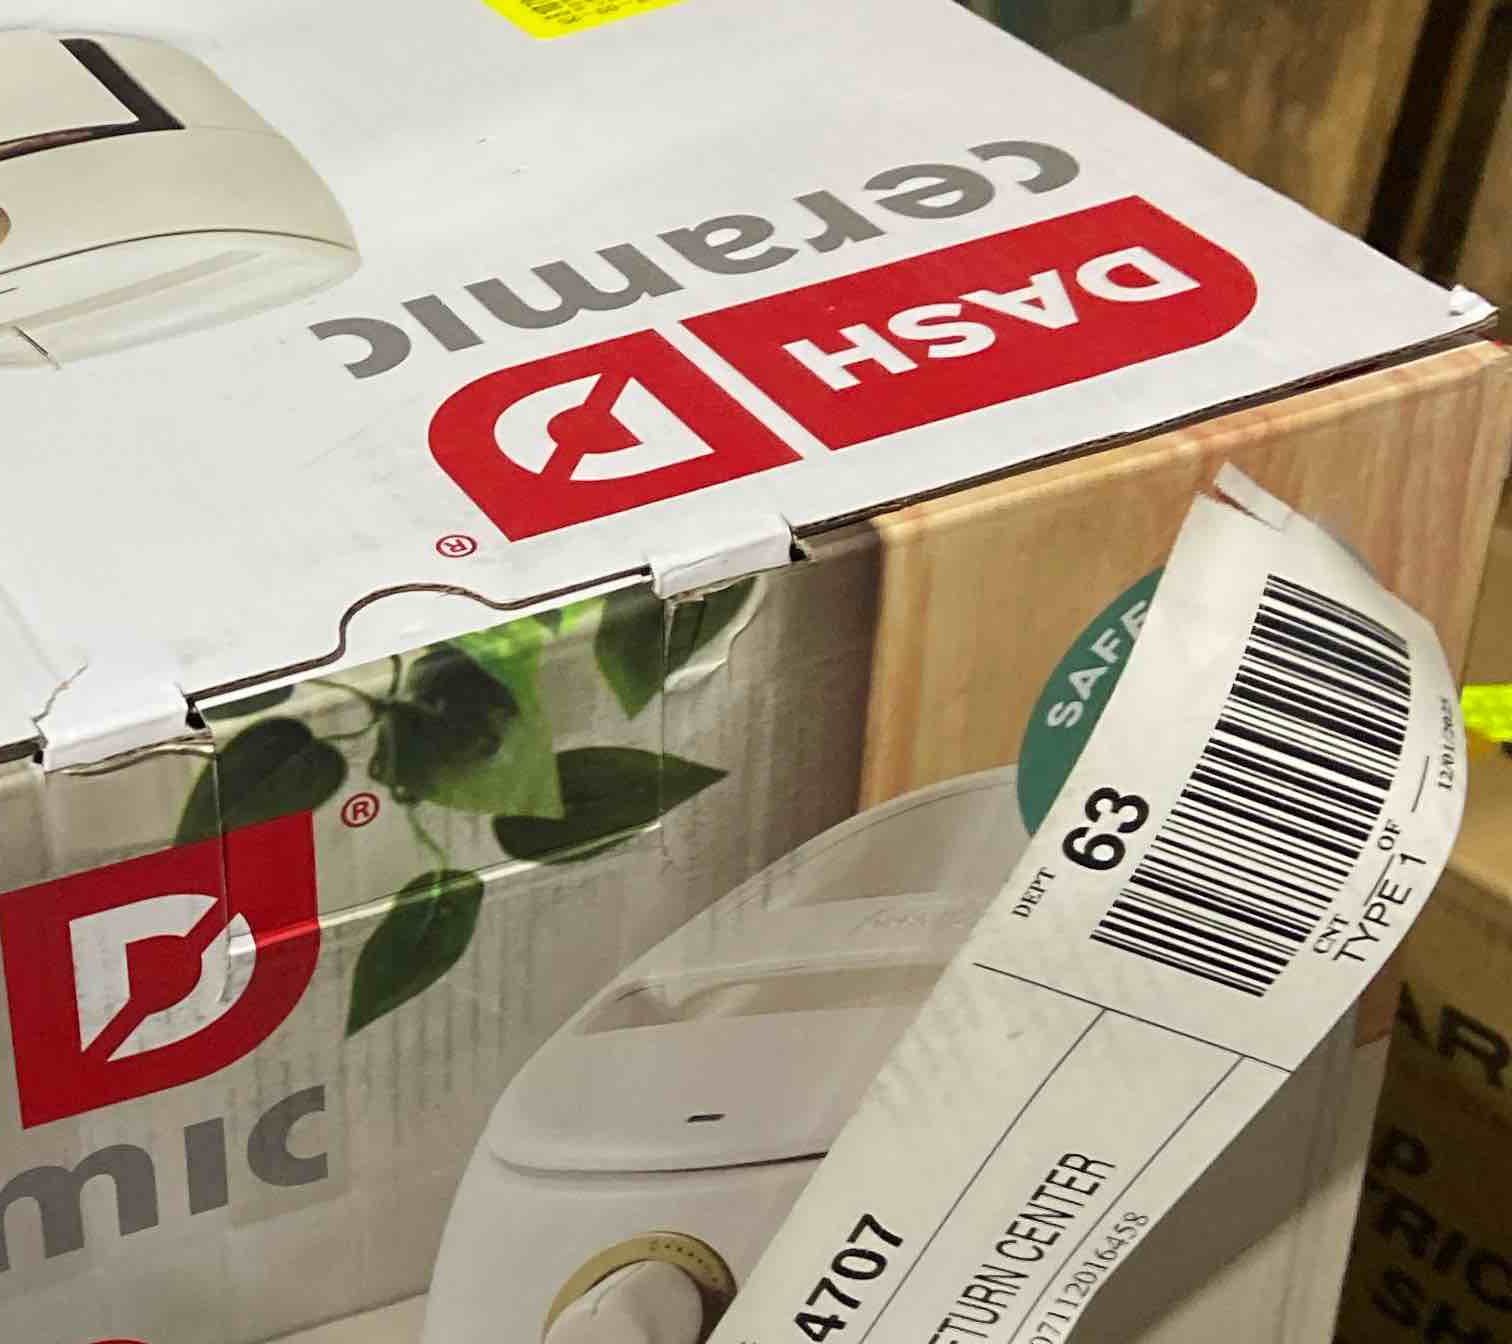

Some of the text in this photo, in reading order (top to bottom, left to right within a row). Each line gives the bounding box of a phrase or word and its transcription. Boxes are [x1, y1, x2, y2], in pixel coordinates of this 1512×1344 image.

[309, 140, 1080, 378] ceramic
[784, 245, 1200, 393] DASH
[1012, 786, 1150, 921] DEPT 63
[1313, 818, 1401, 954] CNT OF
[1333, 853, 1427, 962] TYPE 1
[1001, 1151, 1117, 1266] CENTER
[794, 1212, 905, 1344] 4707
